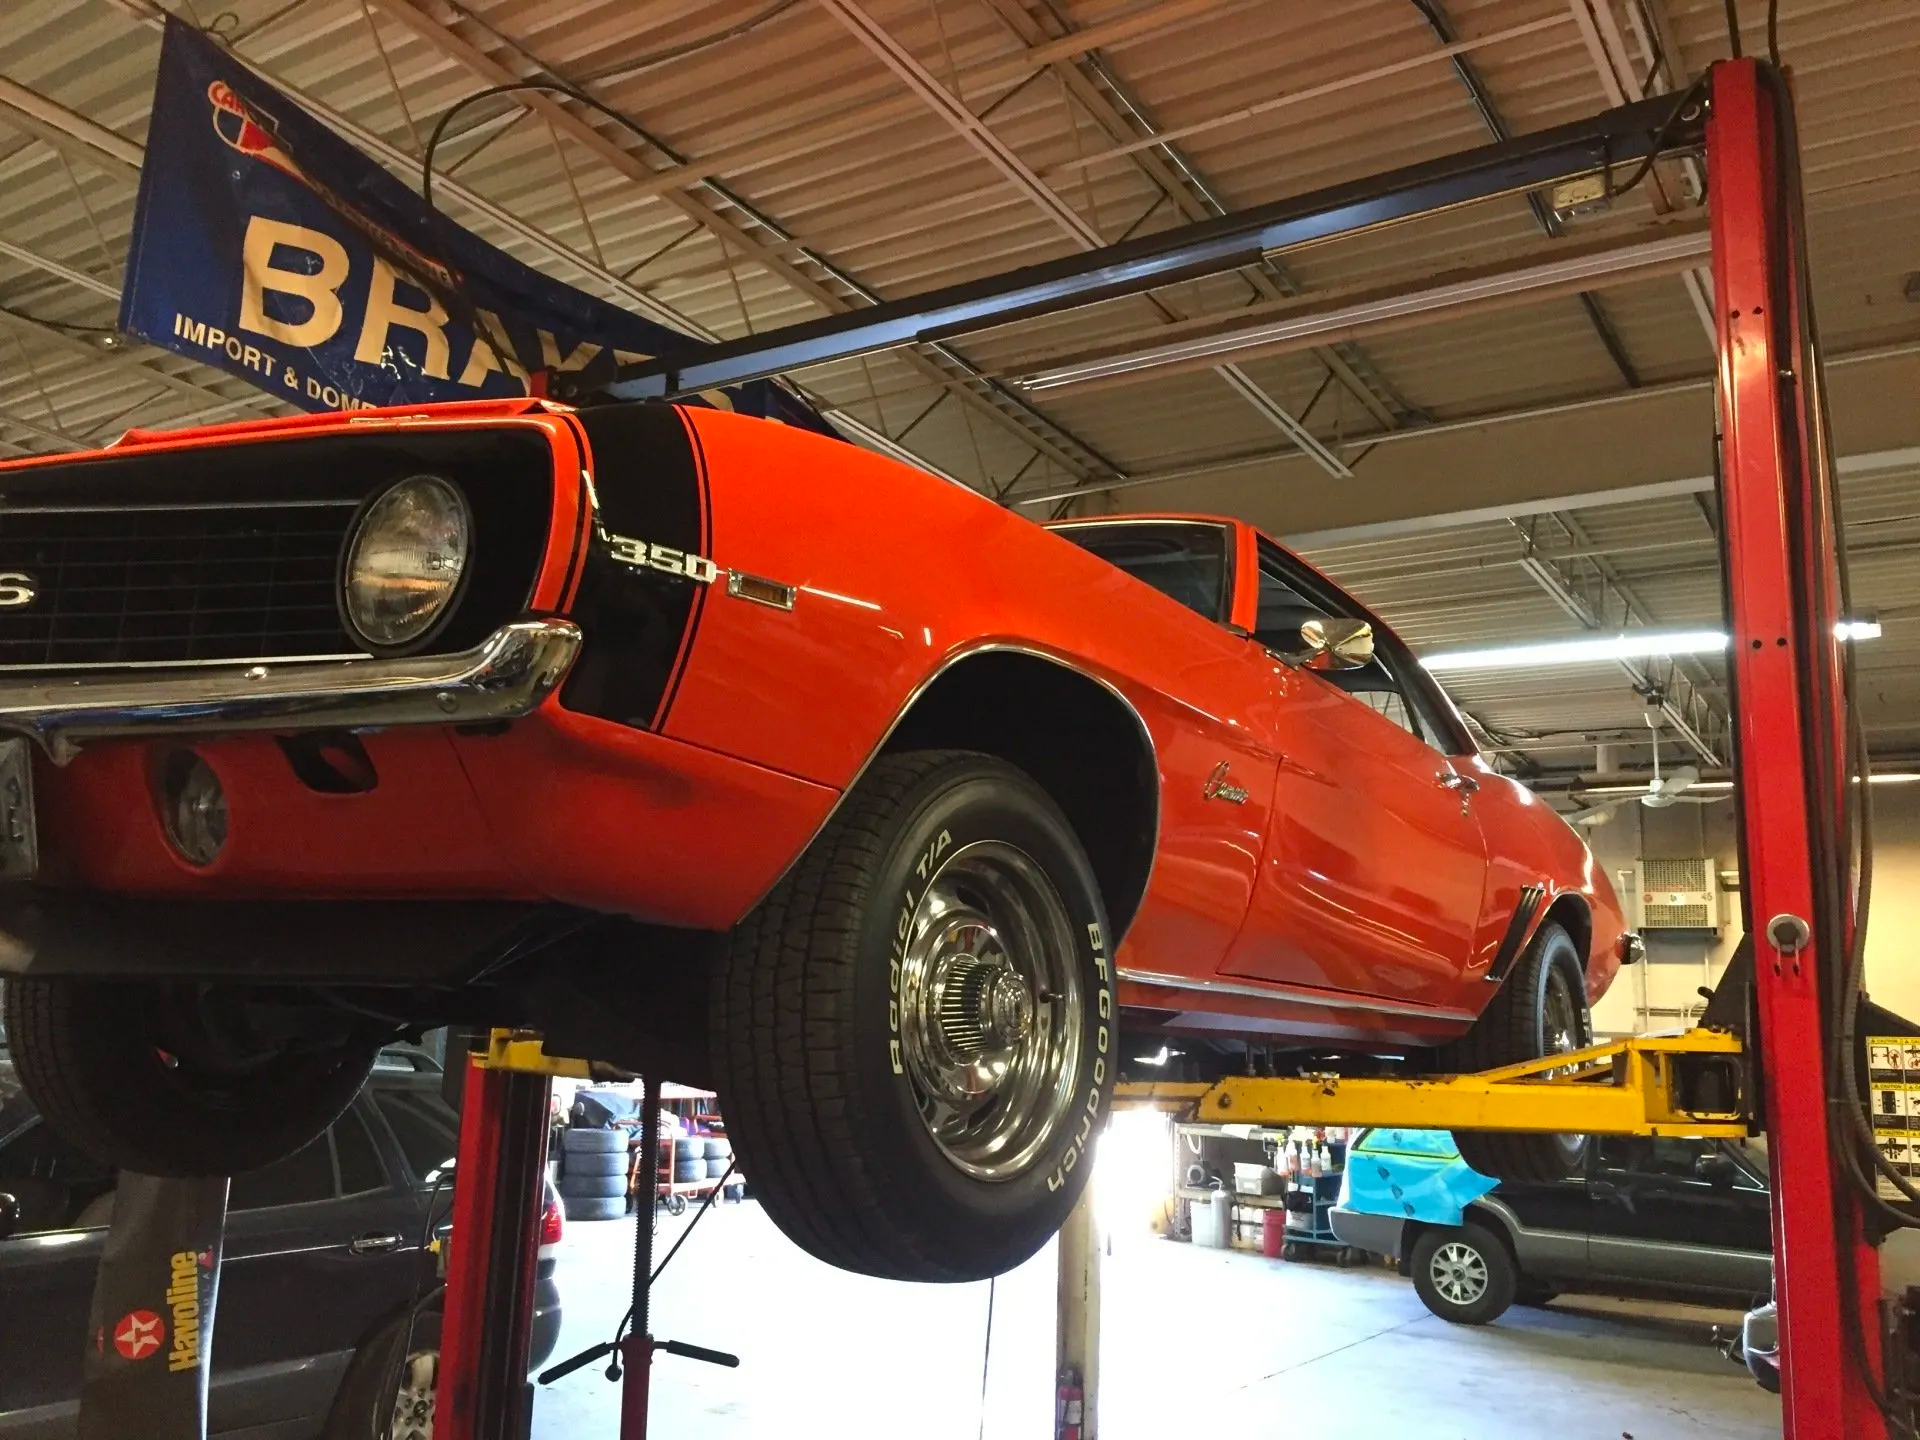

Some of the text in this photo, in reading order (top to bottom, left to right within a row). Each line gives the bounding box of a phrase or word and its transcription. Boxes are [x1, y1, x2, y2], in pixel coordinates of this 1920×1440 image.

[173, 312, 276, 378] IMPORT
[283, 366, 299, 391] &
[610, 534, 717, 584] 350
[889, 890, 916, 1075] Radial
[1047, 921, 1112, 1192] BFGoodrich
[166, 1250, 200, 1373] Havoline
